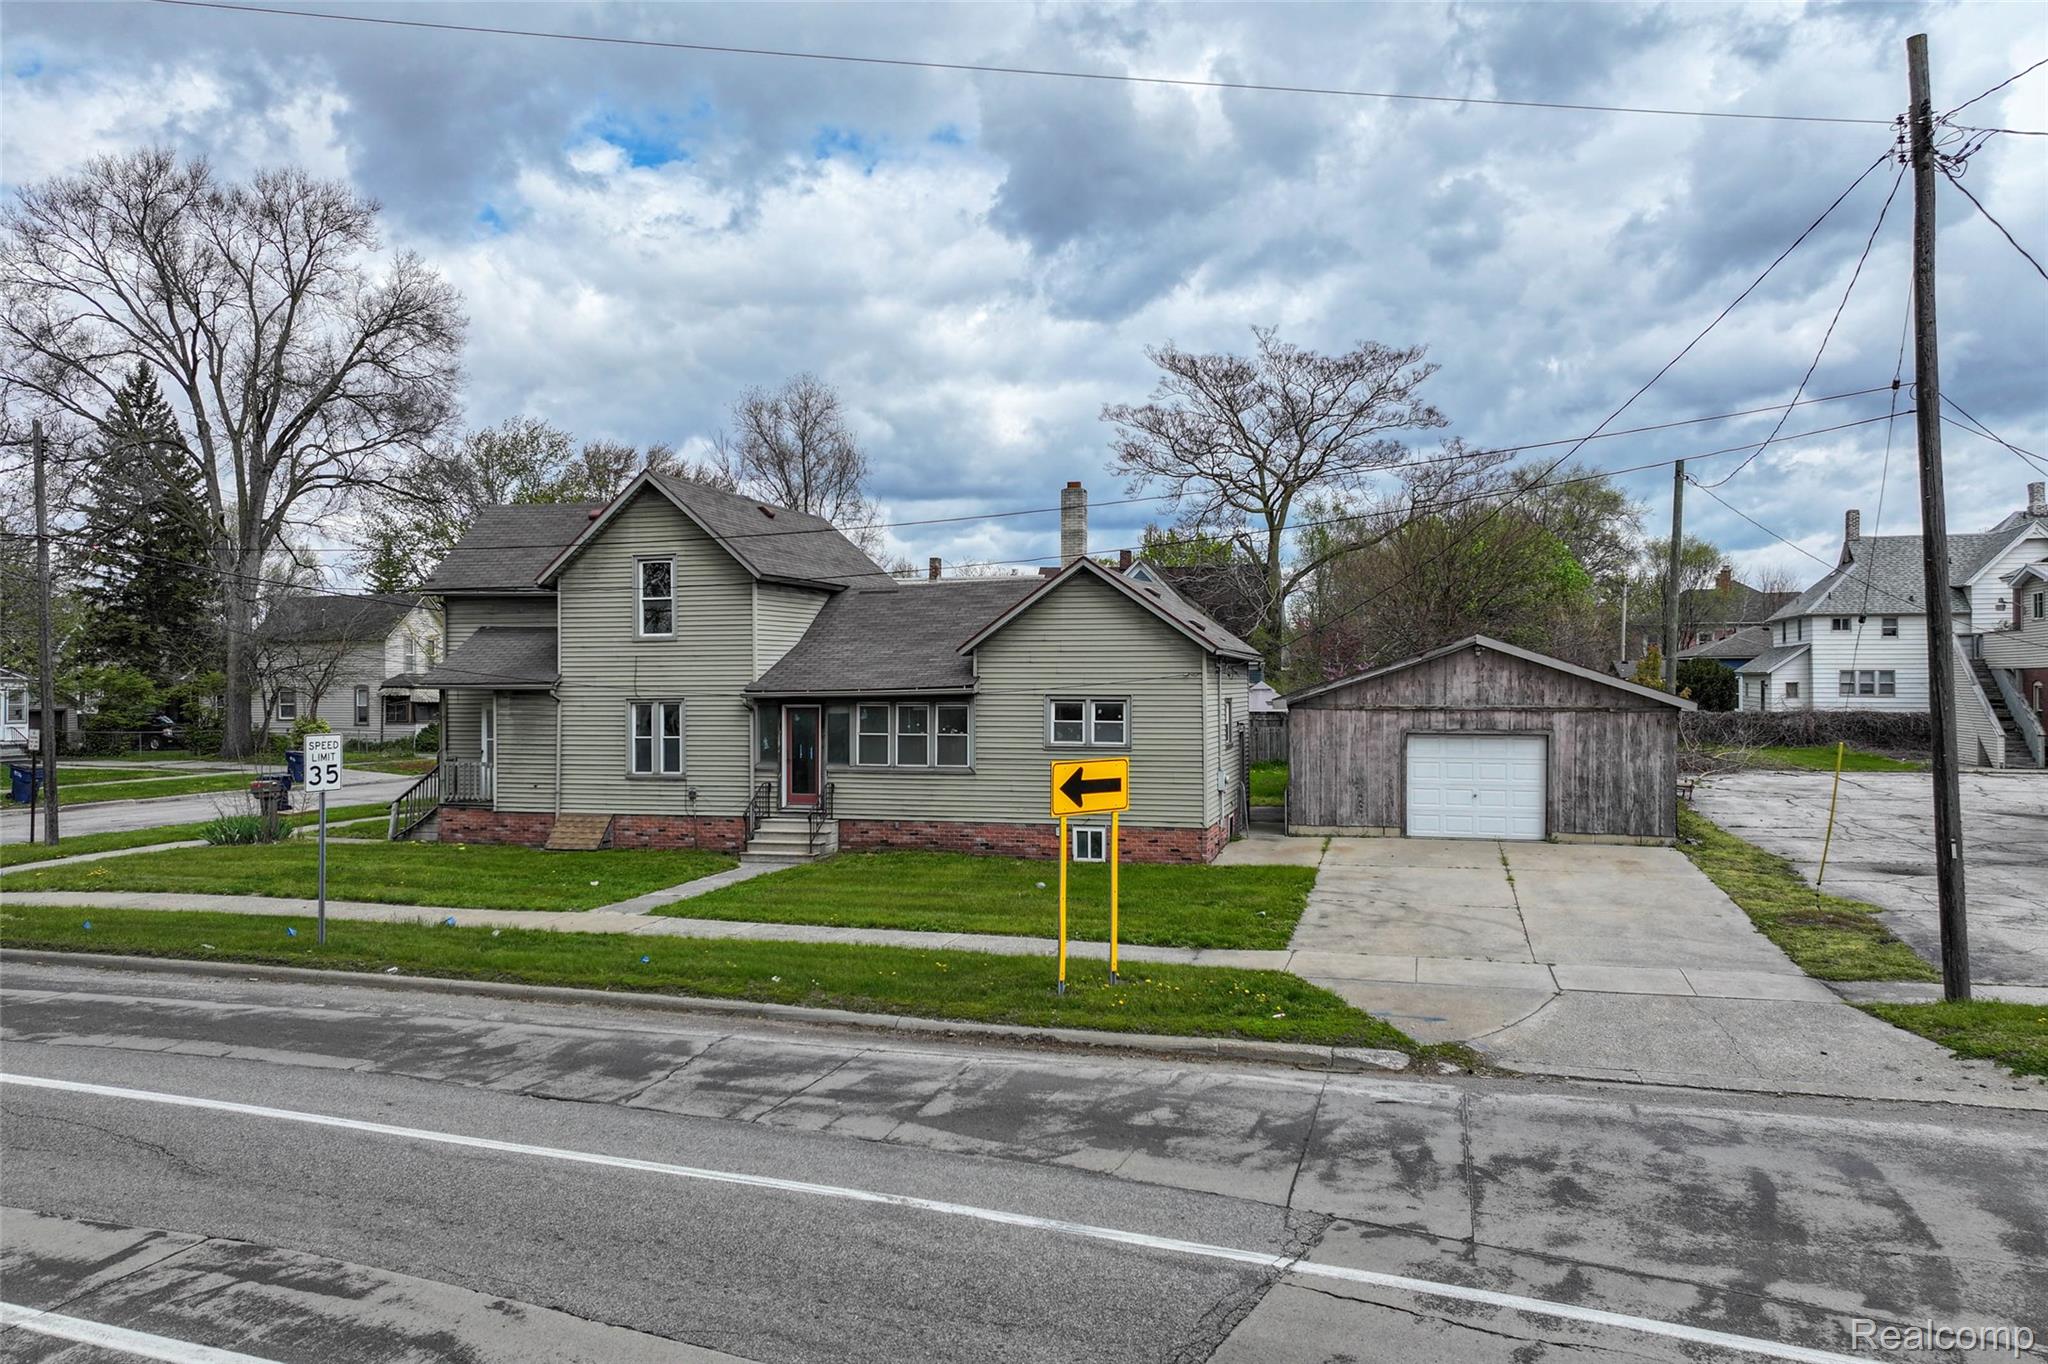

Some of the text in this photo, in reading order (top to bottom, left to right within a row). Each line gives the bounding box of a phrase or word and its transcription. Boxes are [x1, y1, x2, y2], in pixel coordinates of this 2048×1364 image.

[308, 741, 339, 751] SPEED
[312, 752, 336, 762] LIMIT
[309, 764, 339, 785] 35
